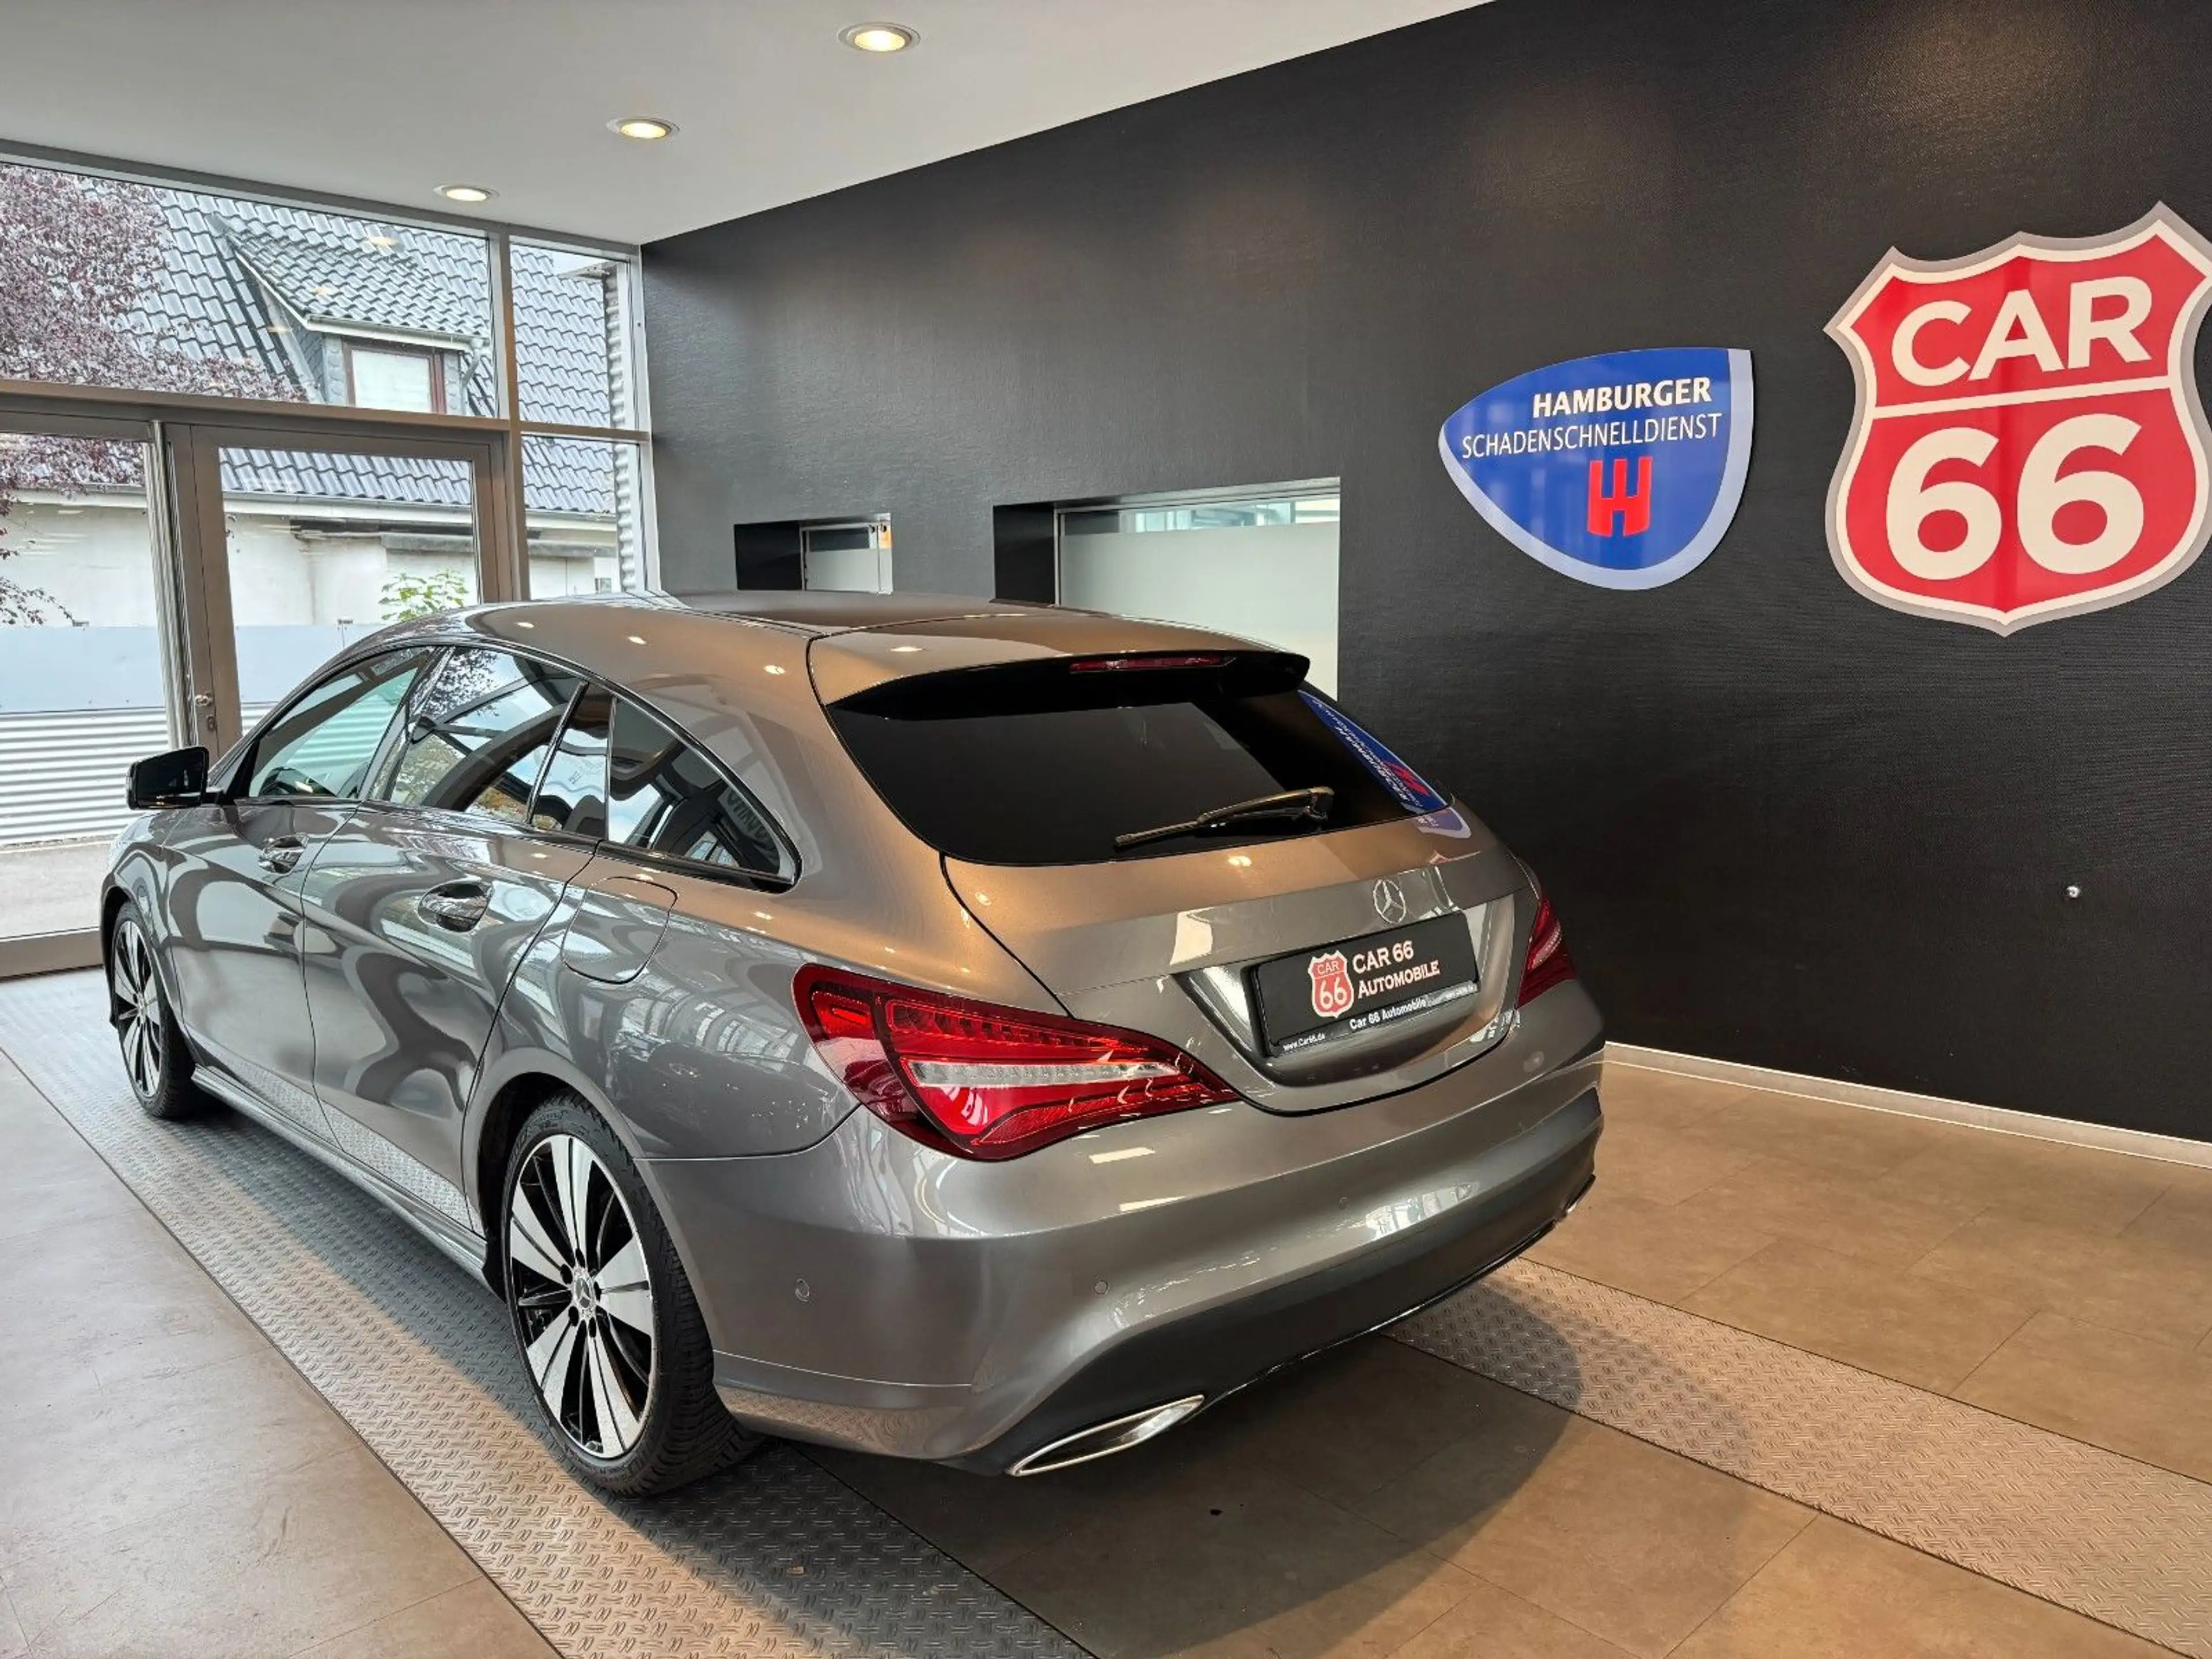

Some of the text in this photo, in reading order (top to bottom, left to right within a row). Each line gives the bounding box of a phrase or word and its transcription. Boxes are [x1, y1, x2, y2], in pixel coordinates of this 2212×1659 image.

[1891, 276, 2152, 387] CAR
[1532, 377, 1712, 418] HAMBURGER
[1463, 412, 1722, 459] SCHADENSCHNELLDIENST
[1886, 413, 2144, 580] 66
[1317, 960, 1340, 975] CAR
[1352, 940, 1415, 974] CAR 66
[1320, 976, 1347, 1009] 66
[1357, 959, 1441, 999] AUTOMOBILE
[1349, 1018, 1367, 1030] Car
